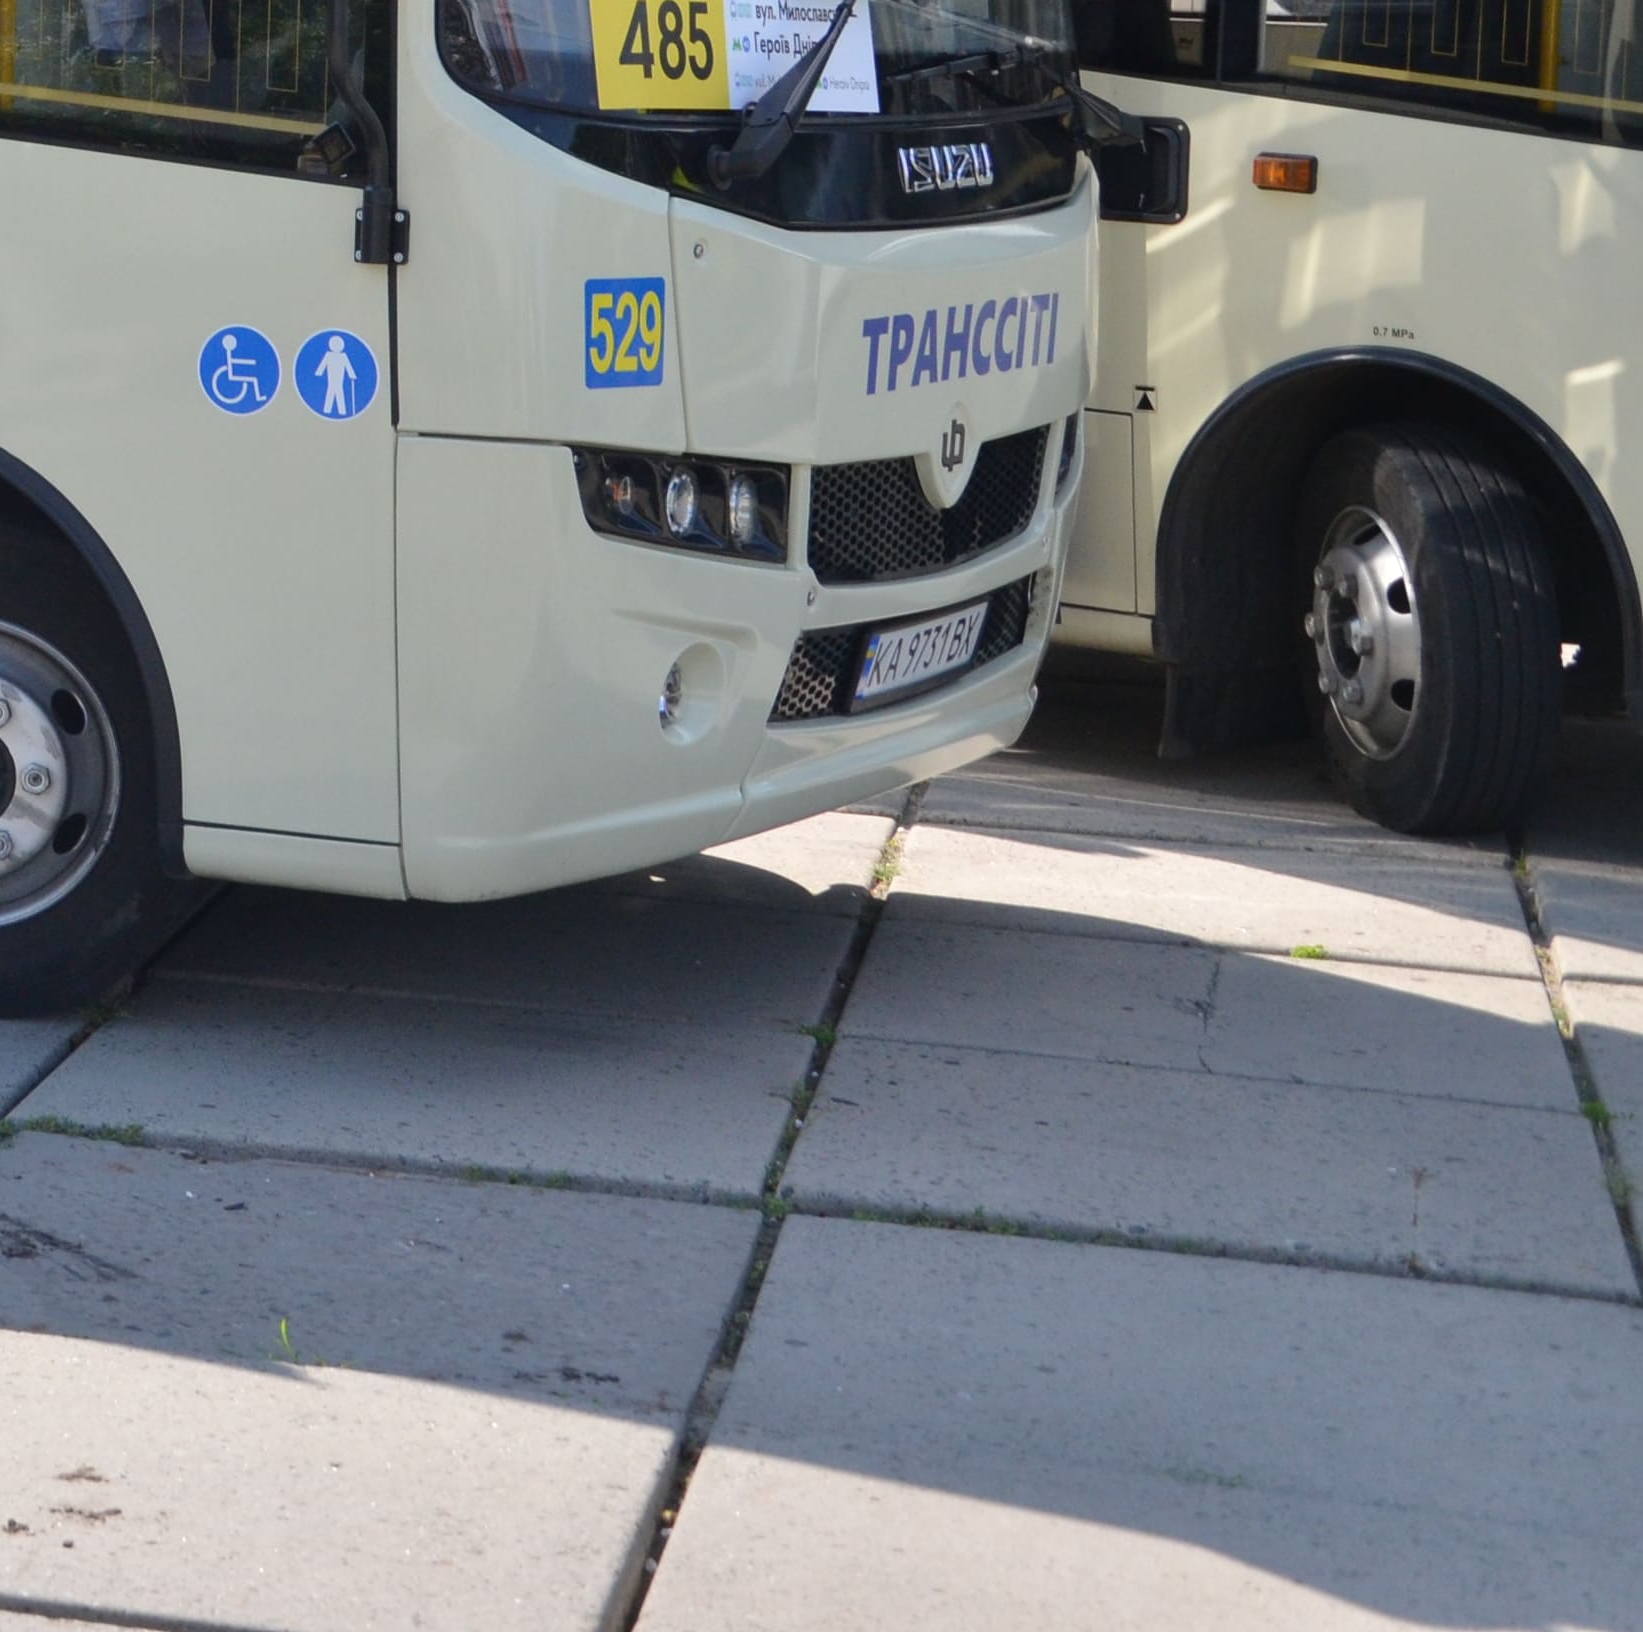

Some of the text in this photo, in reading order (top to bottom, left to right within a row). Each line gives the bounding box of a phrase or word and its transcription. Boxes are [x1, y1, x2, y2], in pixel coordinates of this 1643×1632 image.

[619, 0, 714, 80] 485
[754, 31, 790, 61] Героїв
[755, 5, 776, 27] вул.
[898, 142, 993, 193] ISUZU
[589, 290, 662, 374] 529
[862, 292, 1059, 396] ТРАНССІТІ
